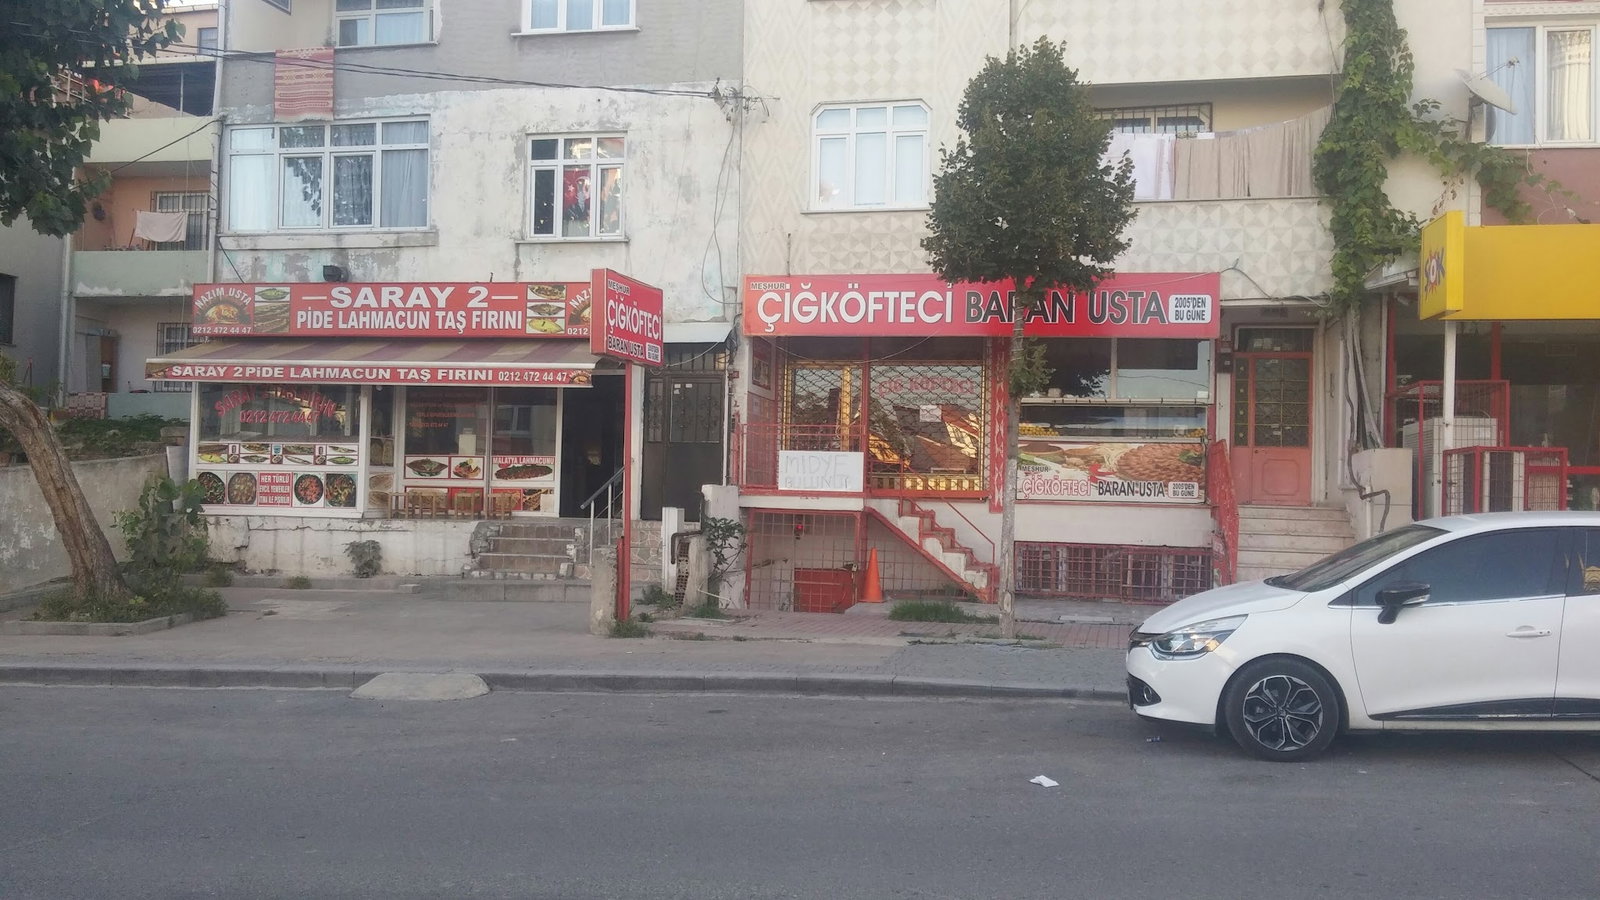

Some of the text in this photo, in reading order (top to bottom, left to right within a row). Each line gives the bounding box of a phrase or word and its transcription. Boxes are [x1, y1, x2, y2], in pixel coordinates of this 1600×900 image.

[751, 281, 786, 291] MEŞHUR
[195, 287, 252, 308] NAZIM USTA
[330, 286, 489, 308] SARAY 2
[1174, 297, 1207, 309] 2005'DEN
[757, 282, 953, 333] ÇİĞKÖFTECİ
[1087, 290, 1169, 324] USTA
[1174, 310, 1185, 321] BU
[297, 307, 523, 334] PİDE LAHMACUN TAŞ FIRINI
[607, 294, 661, 341] ÇİĞKÖFTECİ
[567, 327, 588, 335] 0212
[608, 335, 628, 356] BARAN
[628, 338, 645, 360] USTA
[172, 366, 227, 377] SARAY
[233, 366, 243, 377] 2
[290, 366, 391, 380] LAHMACUN
[397, 368, 431, 383] TAŞ
[437, 369, 493, 381] FIRINI
[498, 371, 520, 382] 0212
[523, 372, 540, 382] 472
[542, 372, 554, 382] 44
[556, 372, 568, 382] 47
[239, 410, 268, 425] 0212
[493, 457, 555, 465] MALATYA LAHMACUNU
[260, 475, 272, 483] HER
[1022, 474, 1166, 499] ÇİĞKÖFTECİ BARAN USTA
